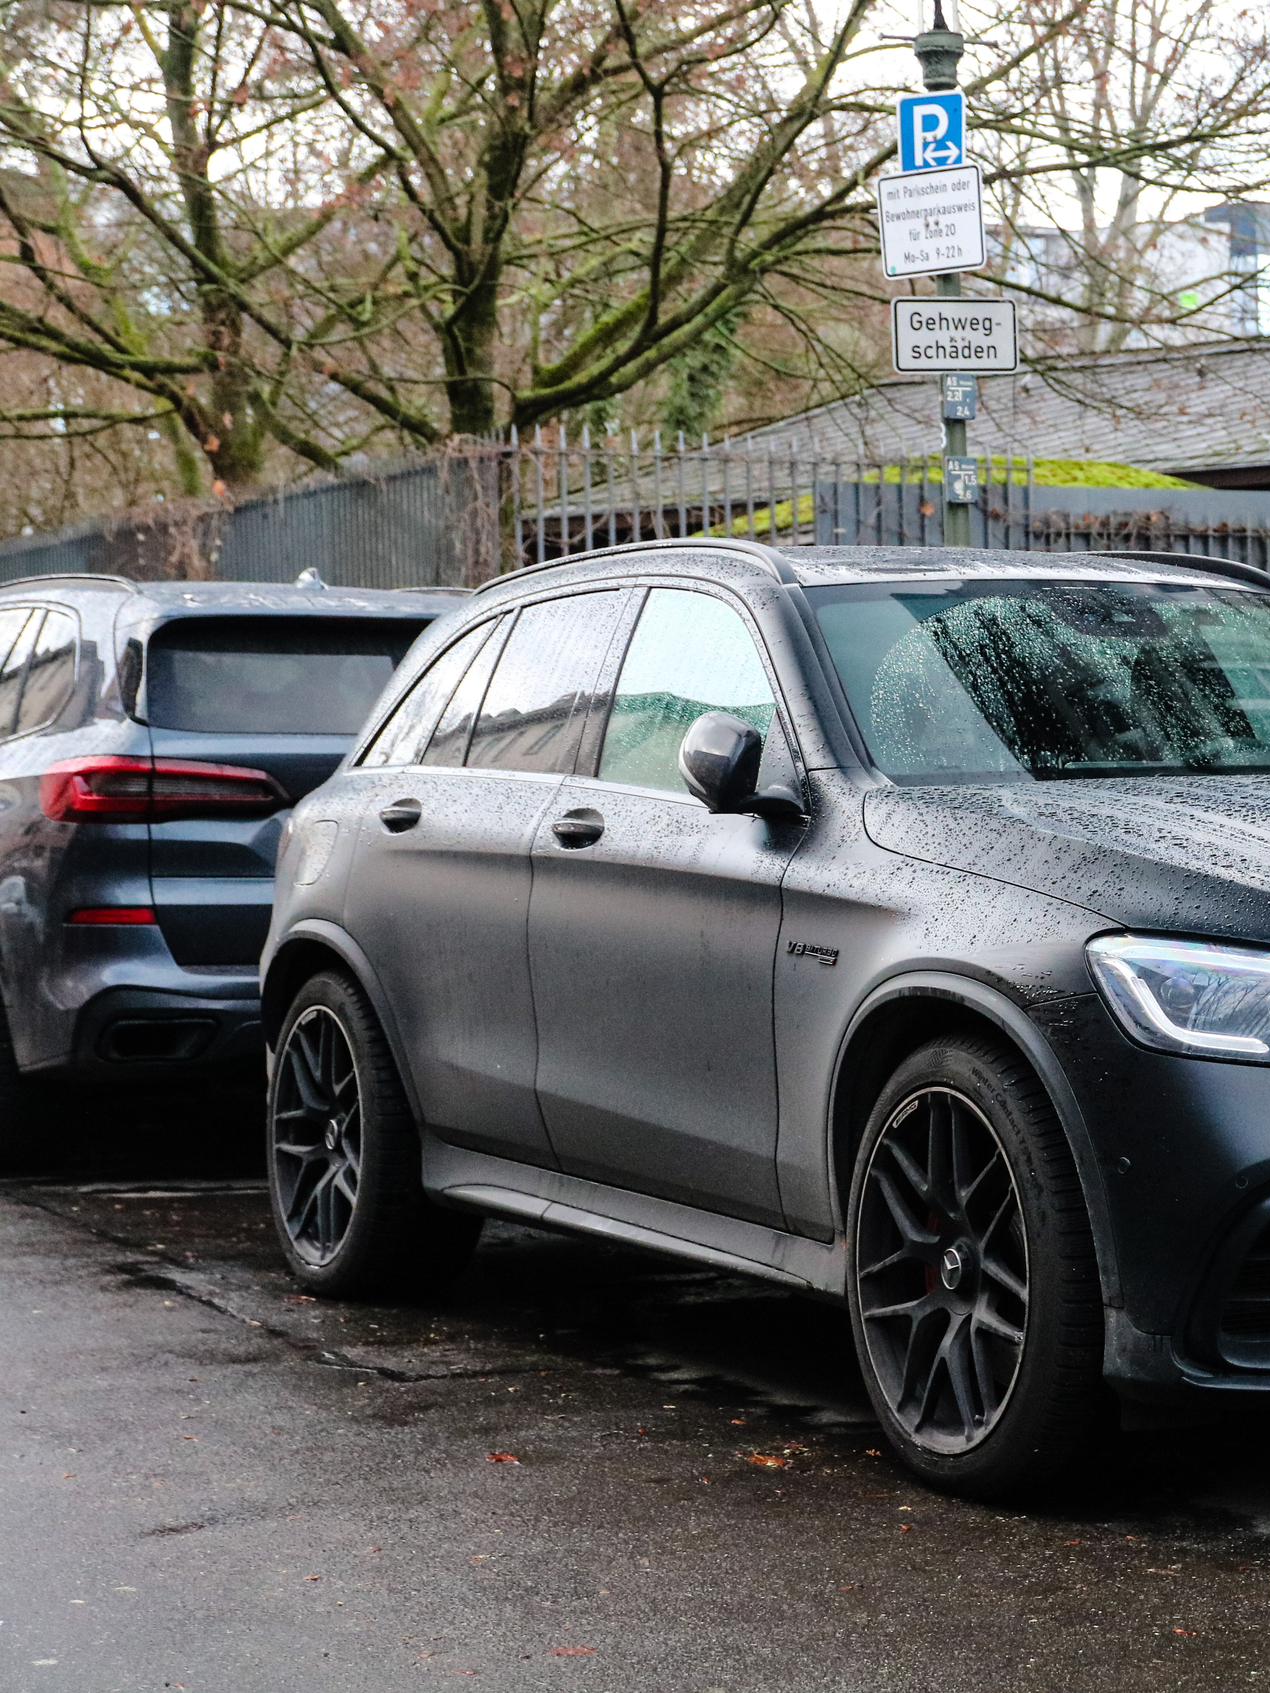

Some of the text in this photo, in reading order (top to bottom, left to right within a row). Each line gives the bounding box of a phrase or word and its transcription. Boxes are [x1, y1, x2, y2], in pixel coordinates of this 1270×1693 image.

[913, 103, 949, 167] P
[887, 178, 970, 200] mit Parkschein oder
[885, 200, 976, 223] Bewohnerparkausweis
[909, 223, 956, 241] für Zone 20
[904, 250, 930, 264] Mo-Sa
[910, 311, 1001, 336] Gehweg-
[911, 339, 997, 359] schäden
[946, 376, 958, 386] AS
[948, 460, 960, 470] AS
